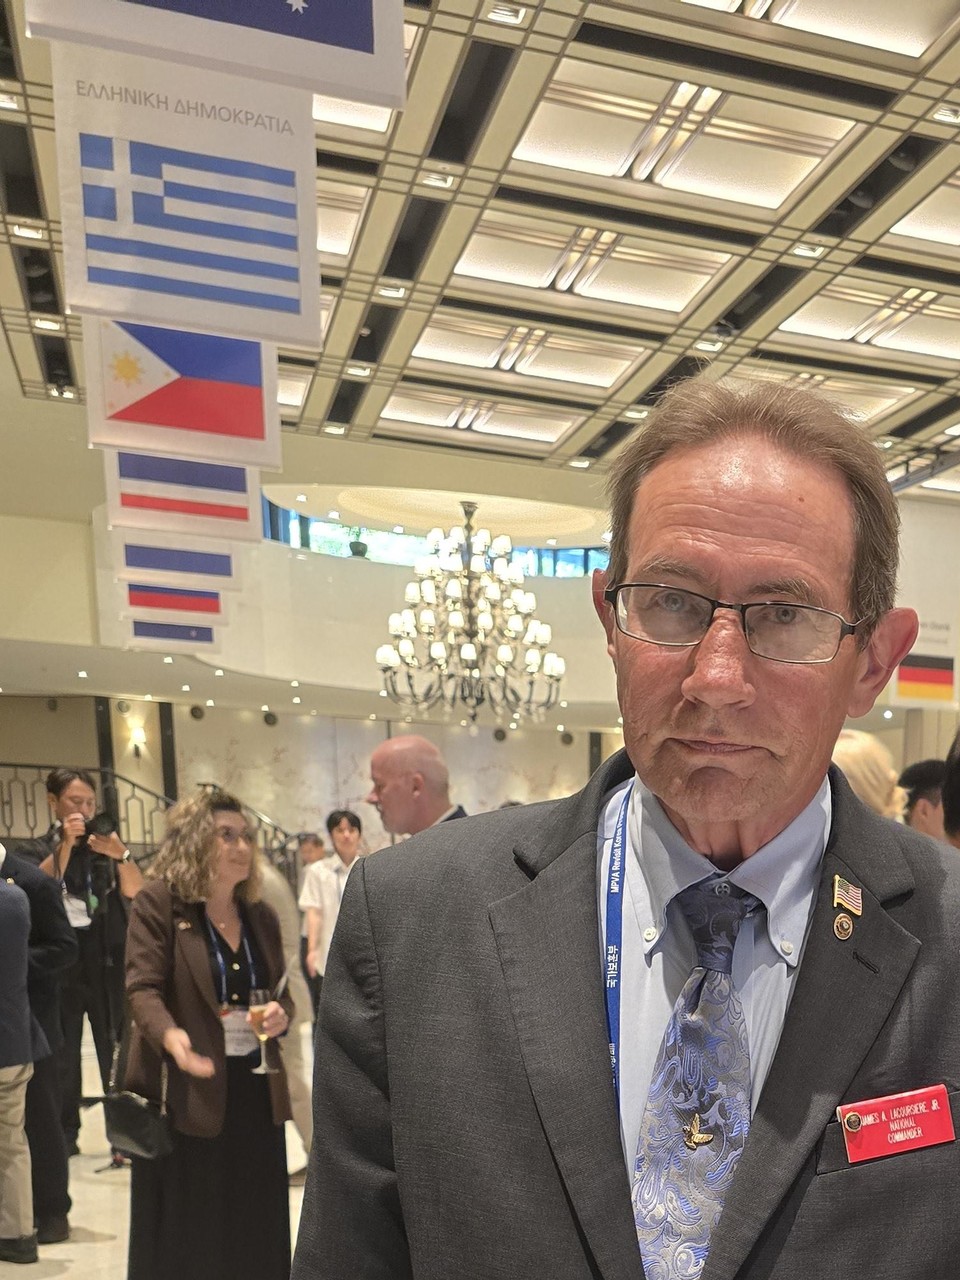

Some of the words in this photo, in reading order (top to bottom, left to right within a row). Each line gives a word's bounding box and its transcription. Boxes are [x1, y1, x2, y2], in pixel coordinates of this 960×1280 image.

[76, 80, 169, 111] ΕΛΛΗΝΙΚΗ
[174, 99, 295, 136] ΔΗΜΟΚΡΑΤΙΑ
[612, 848, 621, 870] Revisit
[610, 872, 620, 893] MPVA
[606, 945, 619, 989] 국가보훈부
[890, 1117, 916, 1131] NATIONAL
[887, 1127, 923, 1143] COMMANDER
